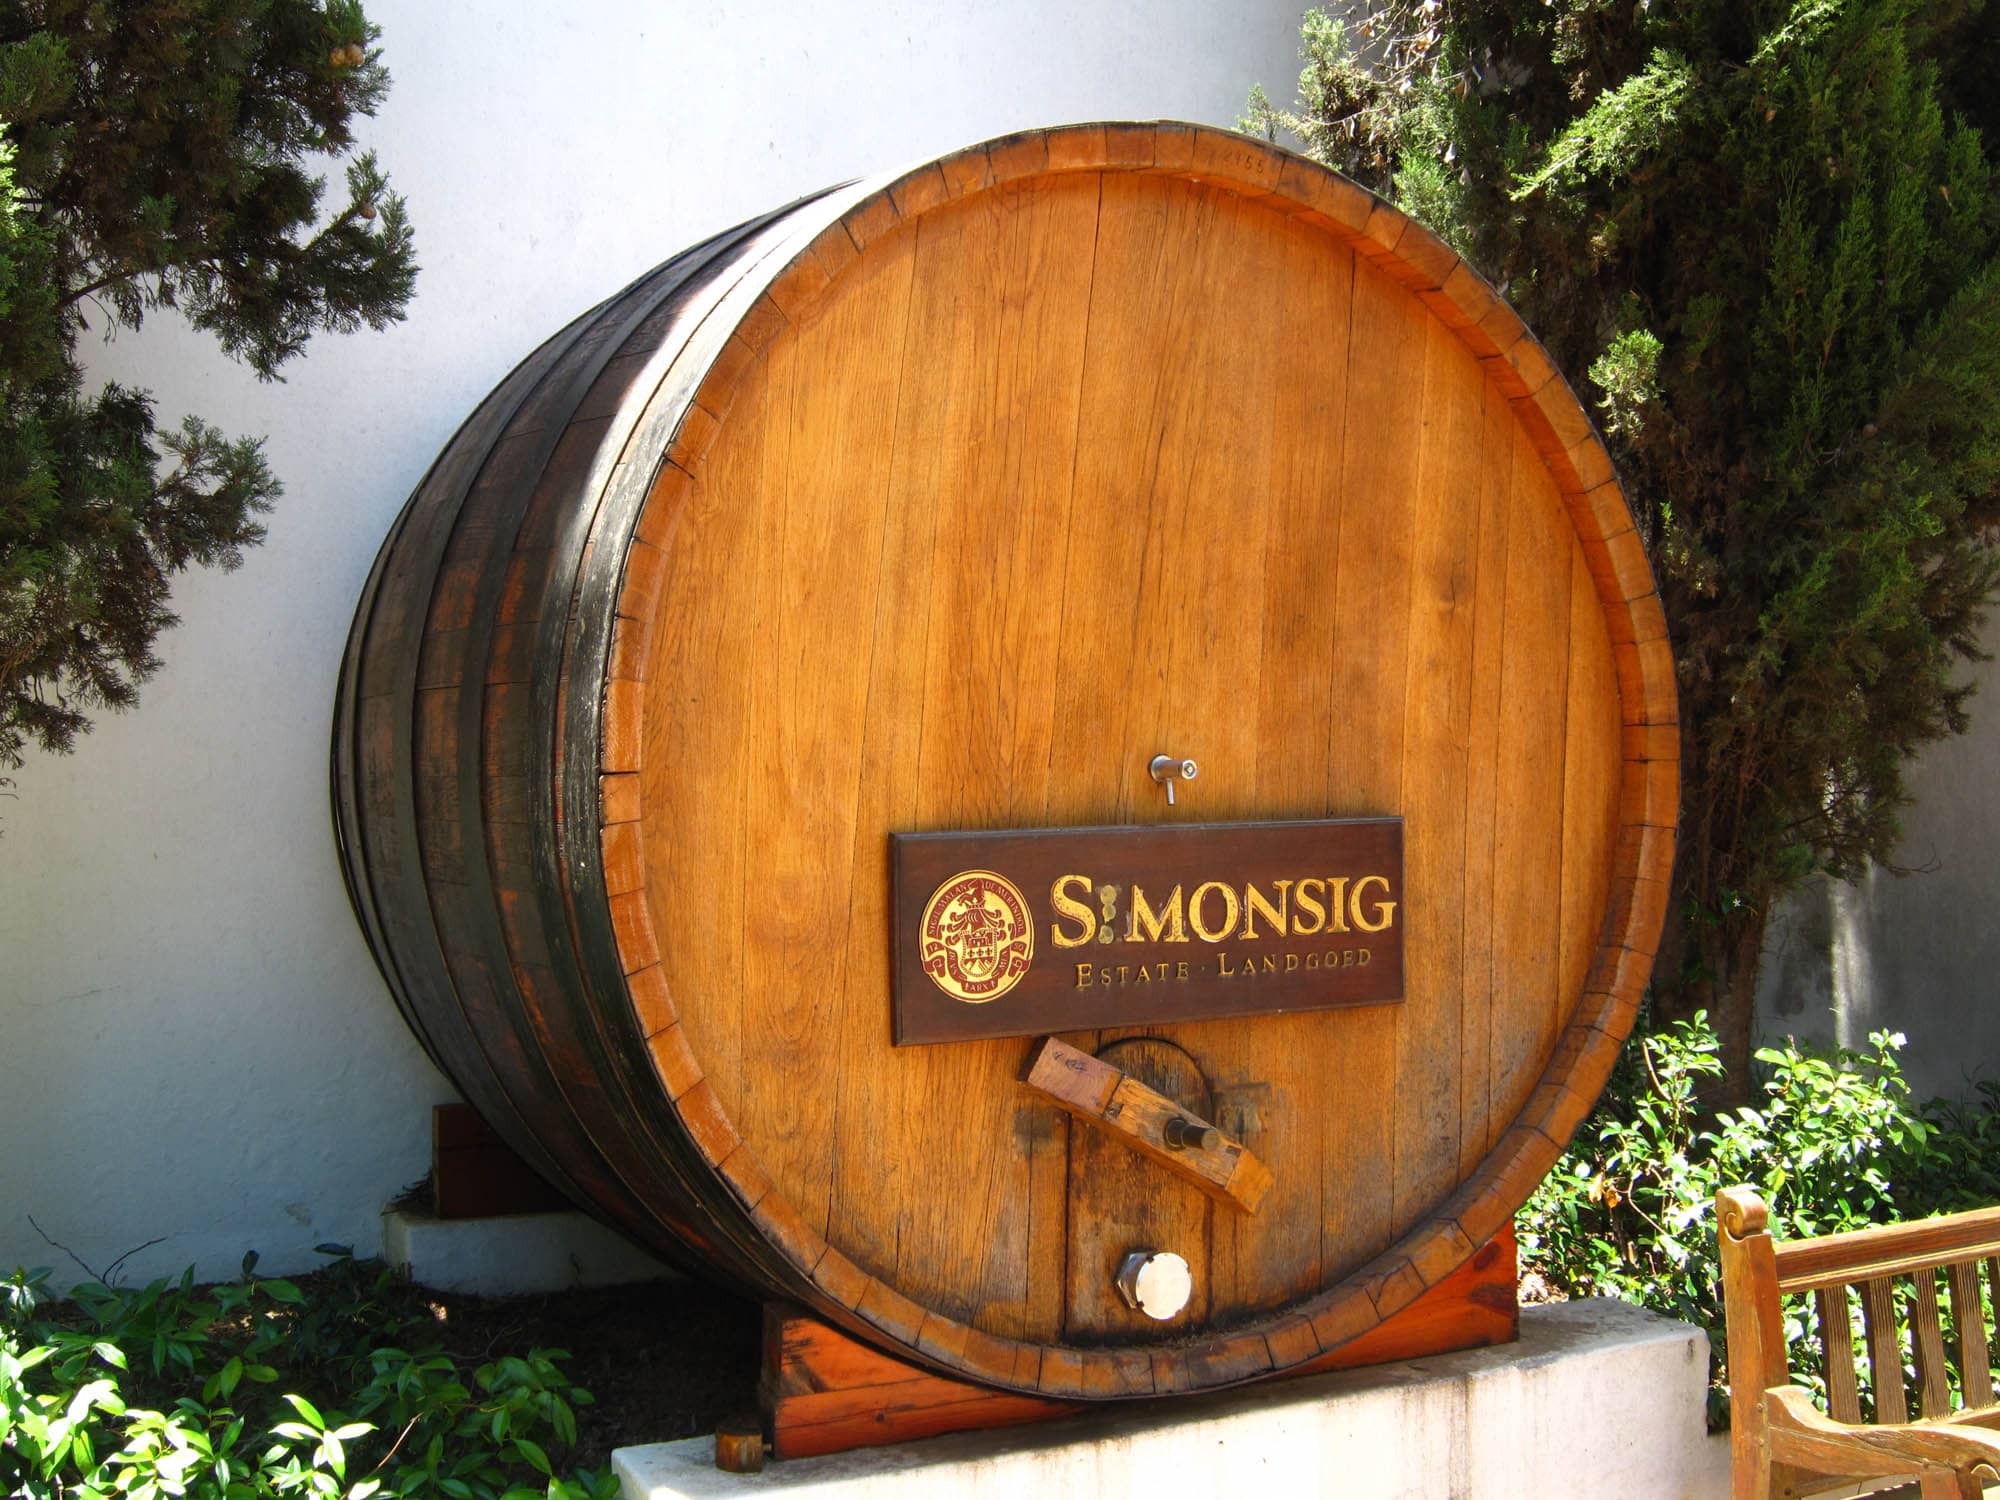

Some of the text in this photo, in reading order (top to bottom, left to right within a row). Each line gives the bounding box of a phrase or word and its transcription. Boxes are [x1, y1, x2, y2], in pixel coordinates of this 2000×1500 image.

[1051, 874, 1397, 948] SMONSIG
[1075, 949, 1371, 991] ESTATE LANDGOED
